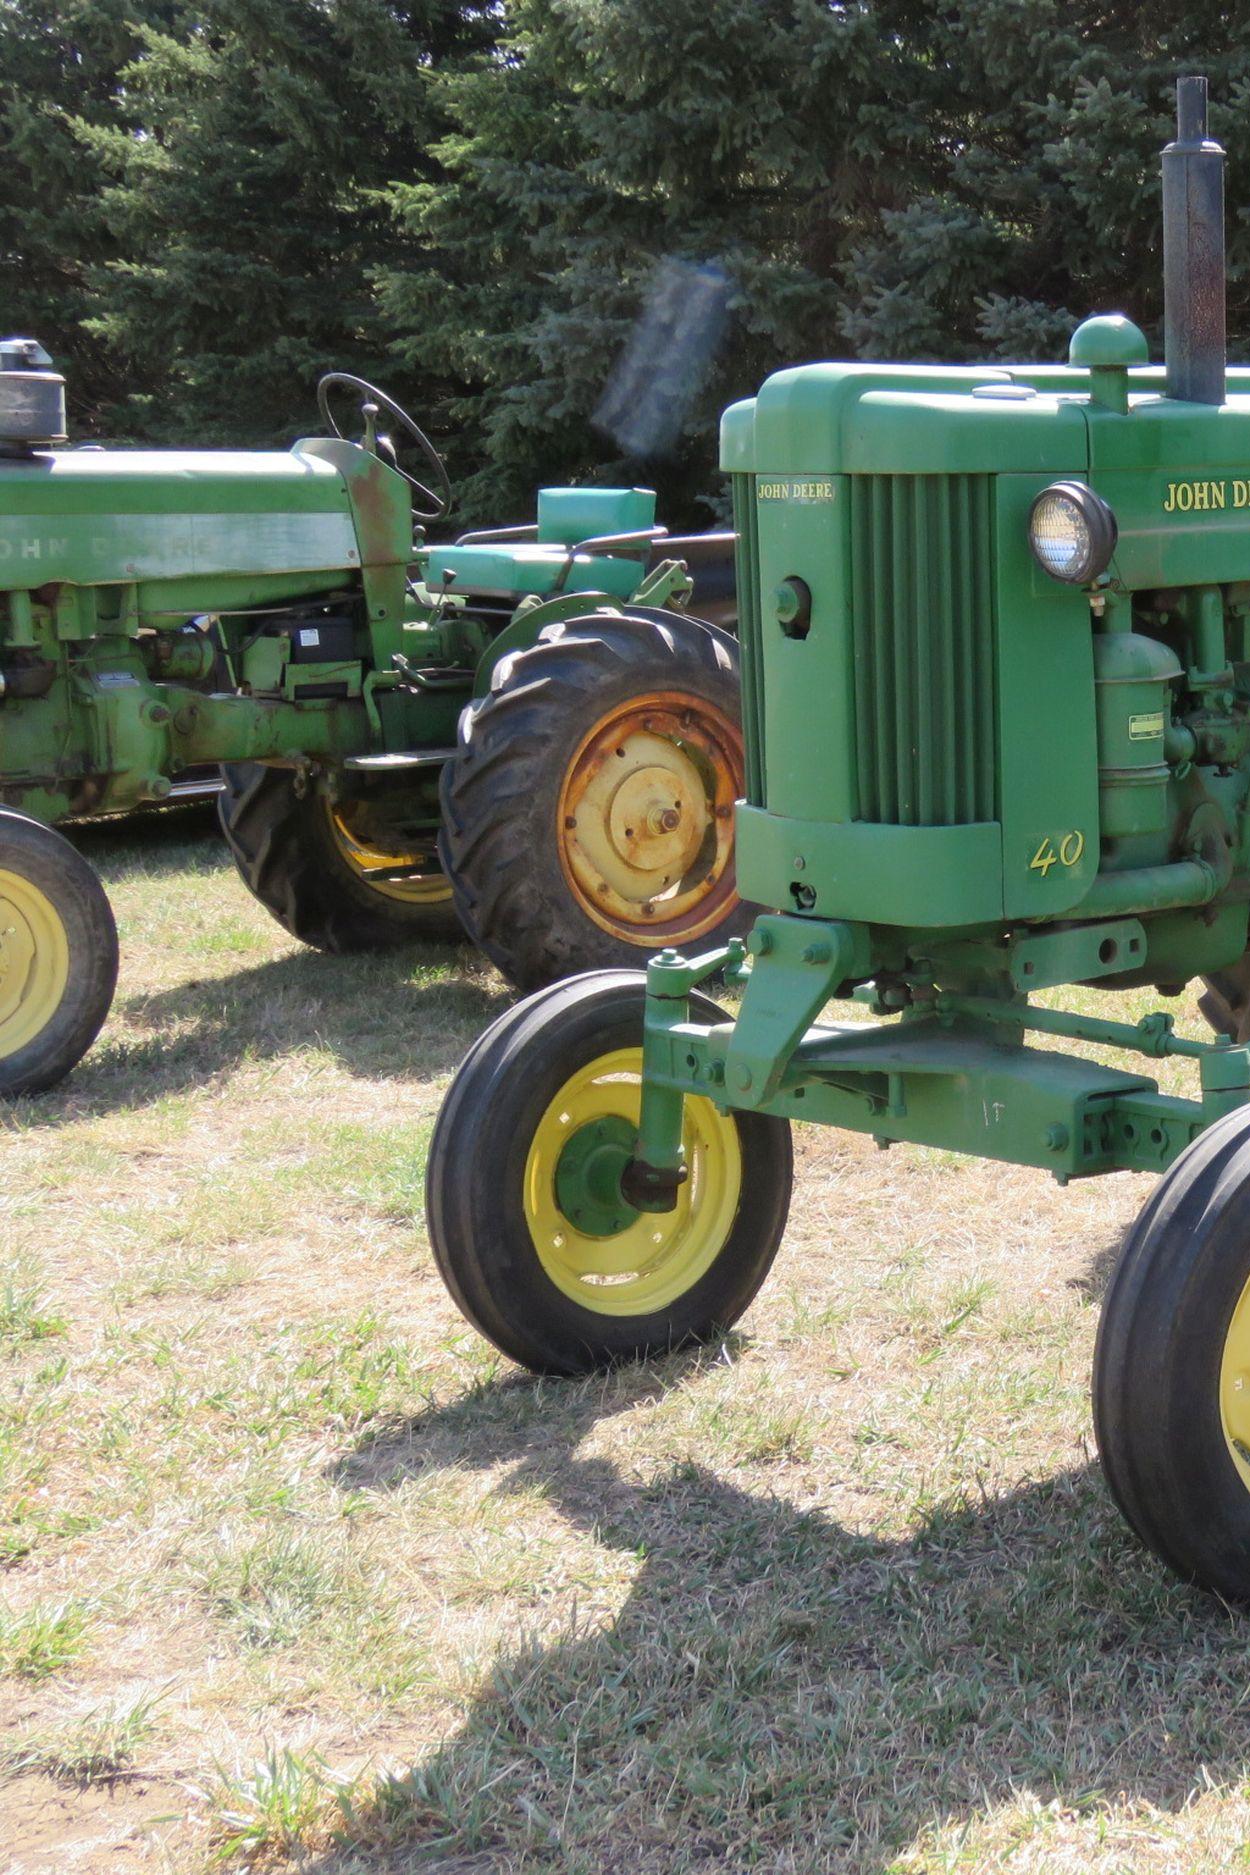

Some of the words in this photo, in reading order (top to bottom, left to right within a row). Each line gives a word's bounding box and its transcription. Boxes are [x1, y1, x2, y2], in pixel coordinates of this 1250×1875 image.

[758, 484, 789, 498] JOHN
[793, 483, 832, 498] DEERE
[1164, 481, 1225, 512] JOHN
[0, 539, 67, 560] OHN
[1030, 830, 1084, 877] 40
